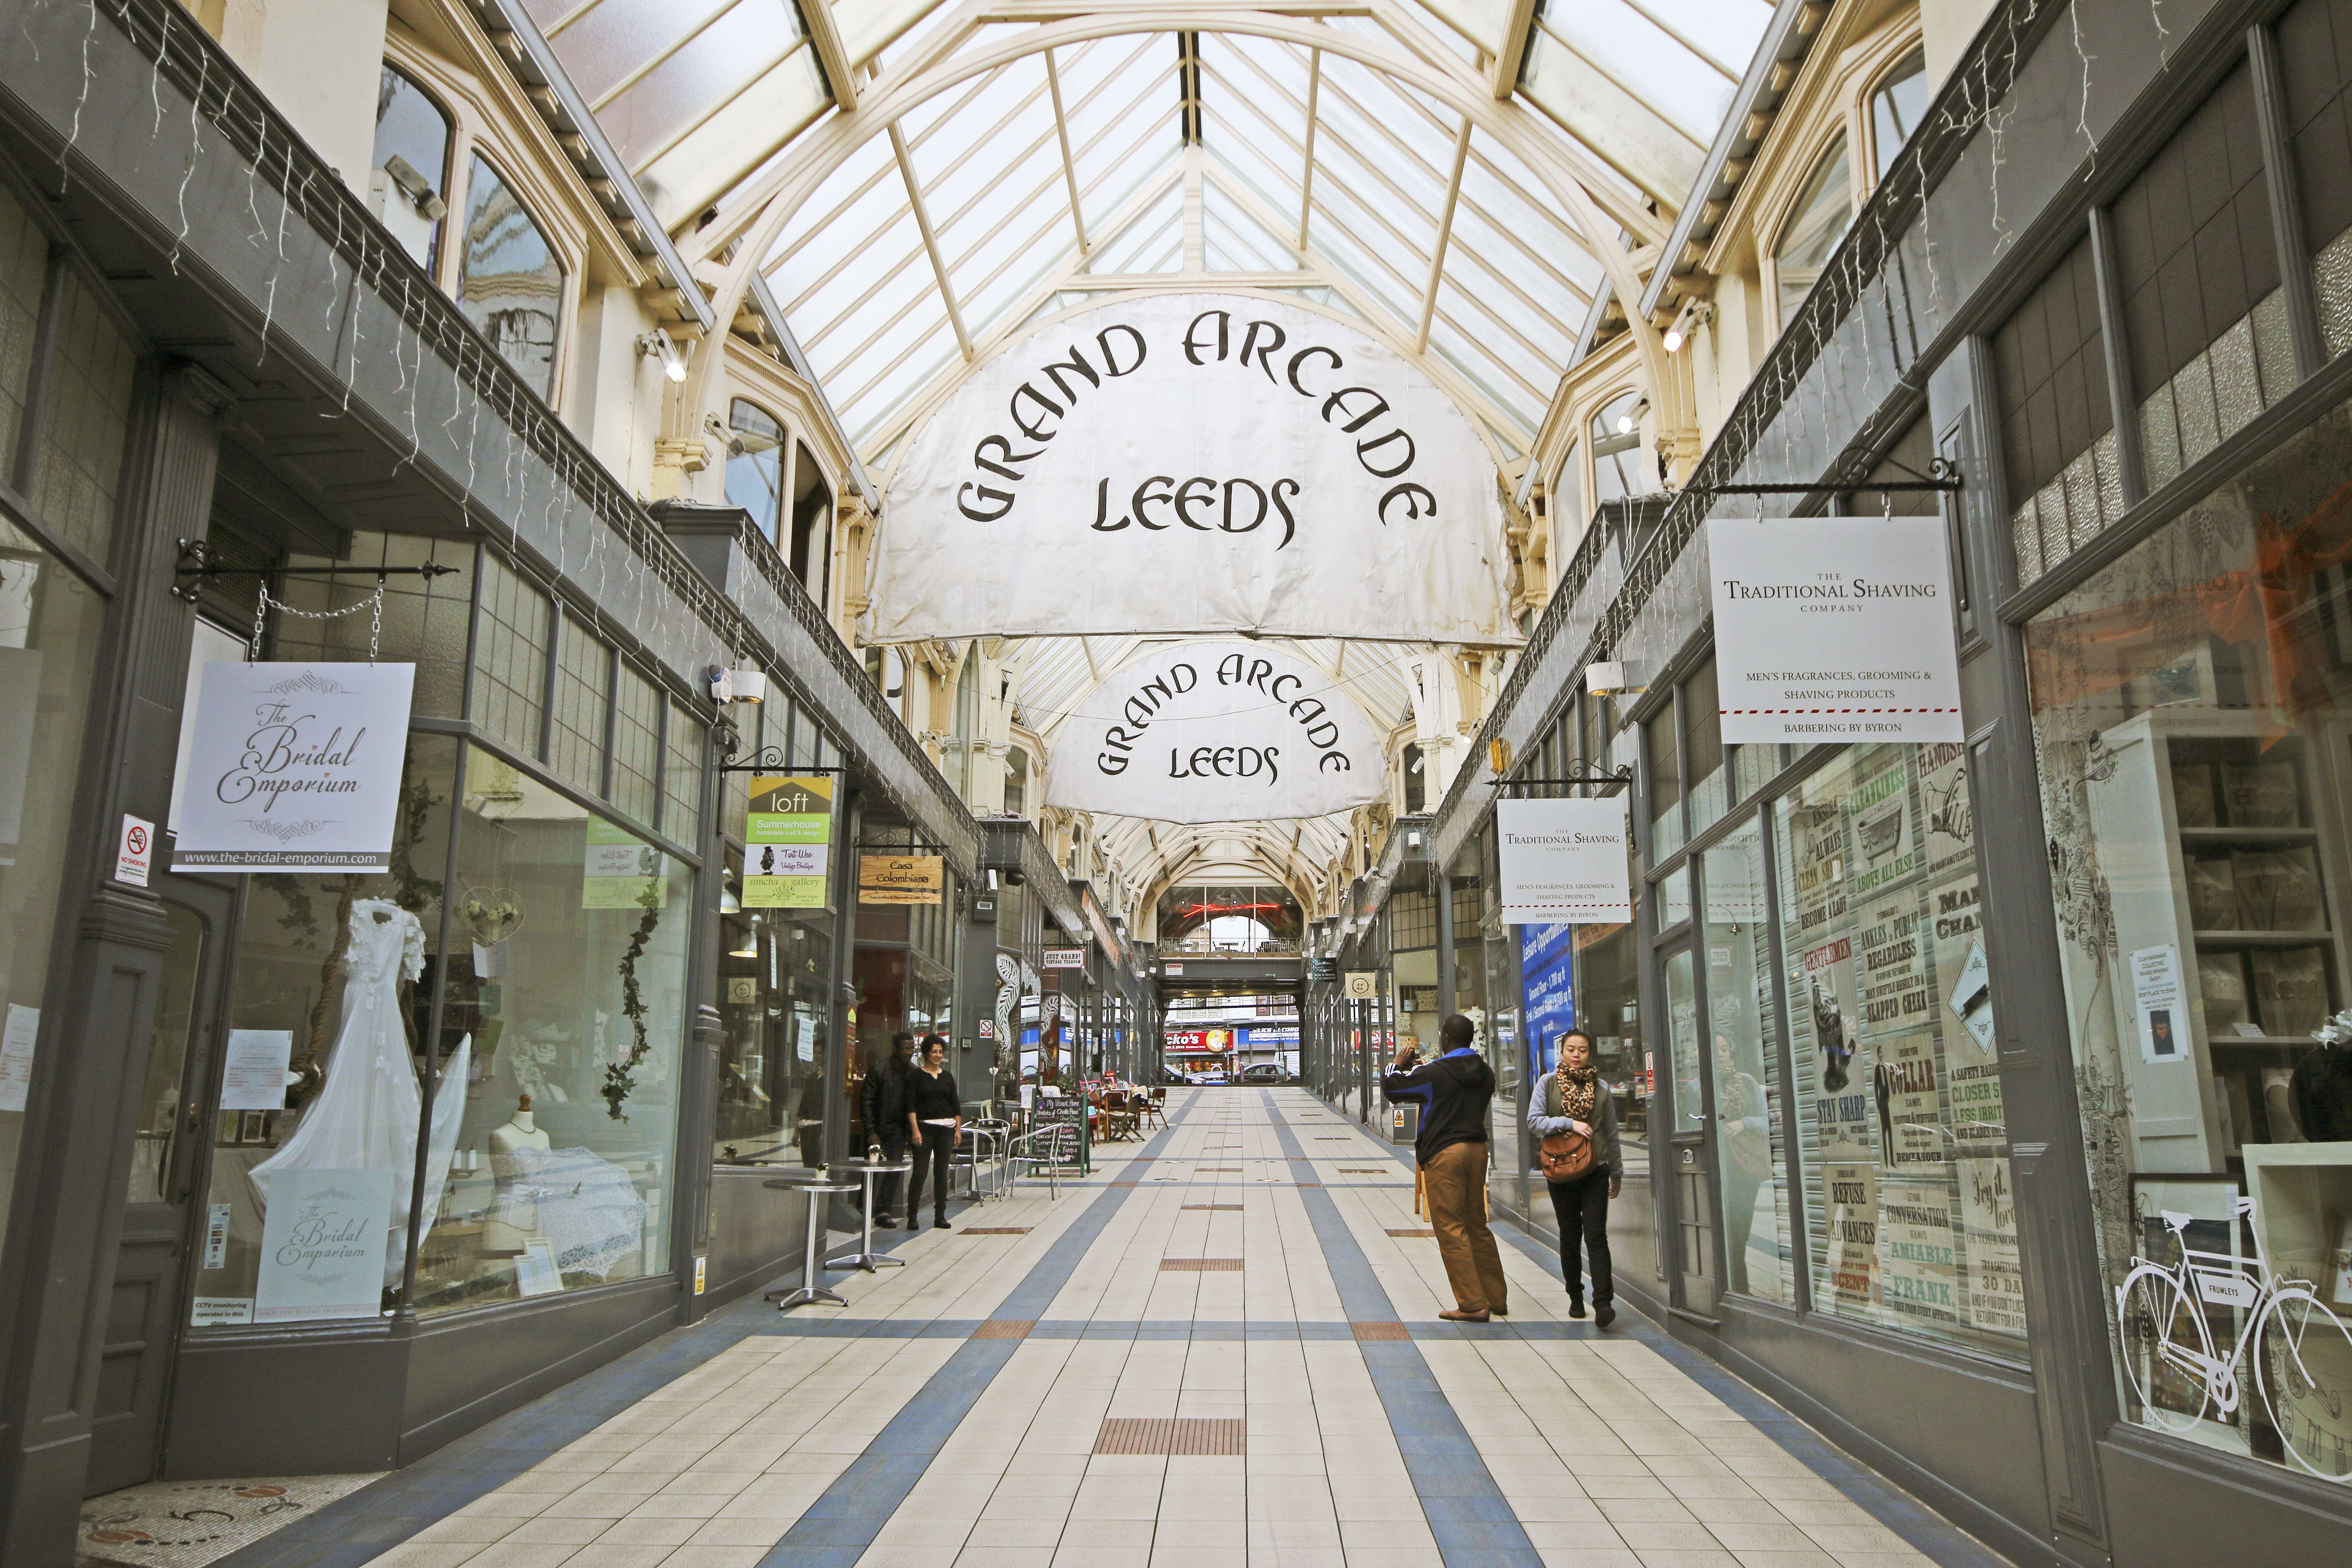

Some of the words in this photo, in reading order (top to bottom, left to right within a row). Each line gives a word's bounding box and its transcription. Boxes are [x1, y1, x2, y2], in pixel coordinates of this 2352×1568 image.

[957, 324, 1147, 522] GRAND
[1182, 310, 1436, 527] ARCADE
[1091, 475, 1300, 551] LEEDS
[1746, 672, 1779, 681] MEN'S
[1782, 671, 1855, 681] FRAGRANCES,
[1858, 671, 1920, 680] GROOMING
[1924, 671, 1932, 680] &
[1784, 690, 1834, 699] SHAVING
[1837, 690, 1895, 698] PRODUCTS
[256, 699, 291, 726] The
[1098, 663, 1197, 775] GRAND
[1216, 654, 1351, 775] ARCADE
[1784, 723, 1846, 732] BARBERING
[1849, 723, 1862, 732] BY
[1865, 723, 1902, 732] BYRON
[246, 715, 366, 776] Bridal
[1169, 747, 1279, 787] LEEDS
[217, 750, 361, 813] Emporium
[1850, 764, 1905, 816] CLEANLINESS
[772, 793, 808, 812] loft
[756, 820, 821, 828] Summerhouse
[1816, 830, 1841, 861] ALWAYS
[185, 852, 377, 865] www.the-bridal-emporium.com
[781, 863, 796, 872] Vintage
[796, 862, 814, 872] Boutique
[791, 878, 819, 887] gallery
[876, 872, 929, 882] Colombiana
[1798, 866, 1818, 892] CLEAN
[1857, 869, 1880, 894] ABOVE
[1881, 863, 1894, 882] ALL
[1895, 852, 1913, 876] ELSE
[1801, 906, 1826, 931] BECOME
[1832, 894, 1847, 917] LADY
[1861, 924, 1886, 951] ANKLES
[1893, 911, 1919, 940] PUBLIC
[1523, 940, 1537, 962] Leisure
[1805, 936, 1851, 971] GENTLEMEN
[1867, 938, 1917, 971] REGARDLESS
[1529, 985, 1539, 1001] Ground
[1557, 973, 1562, 985] sq
[1562, 966, 1565, 980] ft
[1866, 987, 1875, 999] MAY
[1876, 982, 1896, 997] SWIFTLY
[1896, 977, 1914, 992] RESULT
[1920, 974, 1925, 984] A
[1534, 1001, 1545, 1019] Second
[1563, 992, 1568, 1006] sq
[1568, 986, 1571, 1000] ft
[1867, 997, 1899, 1023] SLAPPED
[1902, 989, 1927, 1015] CHEEK
[1890, 1058, 1936, 1095] COLLAR
[1951, 1069, 1955, 1081] A
[1956, 1066, 1979, 1080] SAFETY
[1952, 1083, 1991, 1102] CLOSER
[1047, 1100, 1054, 1109] My
[1817, 1098, 1836, 1124] STAY
[1839, 1095, 1865, 1122] SHARP
[1954, 1109, 1976, 1122] LESS
[1957, 1128, 1968, 1139] AND
[1969, 1127, 1991, 1139] BLADES
[1896, 1152, 1942, 1162] DEMEANOUR
[1831, 1182, 1866, 1204] REFUSE
[1973, 1171, 1993, 1215] Try
[1887, 1205, 1948, 1228] CONVERSATION
[294, 1212, 369, 1247] Bridal
[1831, 1220, 1875, 1245] ADVANCES
[1966, 1233, 1976, 1243] OR
[1977, 1233, 1998, 1245] YOUR
[276, 1232, 365, 1270] Emporium
[1892, 1242, 1952, 1265] AMIABLE
[1981, 1259, 1990, 1271] TRY
[1991, 1261, 1994, 1271] A
[1994, 1261, 2011, 1273] SAFETY
[1831, 1271, 1869, 1292] SCENT
[1893, 1276, 1956, 1307] FRANK,
[1982, 1276, 1998, 1291] 30
[2209, 1285, 2239, 1296] FRUMLEYS
[1894, 1301, 1904, 1311] FREE
[1905, 1303, 1917, 1314] FROM
[1917, 1305, 1931, 1318] EVERY
[1972, 1293, 1981, 1307] AND
[1982, 1294, 1987, 1306] IF
[1987, 1296, 1997, 1309] YOU
[1997, 1297, 2012, 1311] DON'T
[2012, 1298, 2024, 1313] LIKE
[1976, 1310, 1995, 1325] RETURN
[2001, 1314, 2011, 1327] FOR
[2012, 1316, 2015, 1328] A
[2181, 1348, 2195, 1358] STUDIOS
